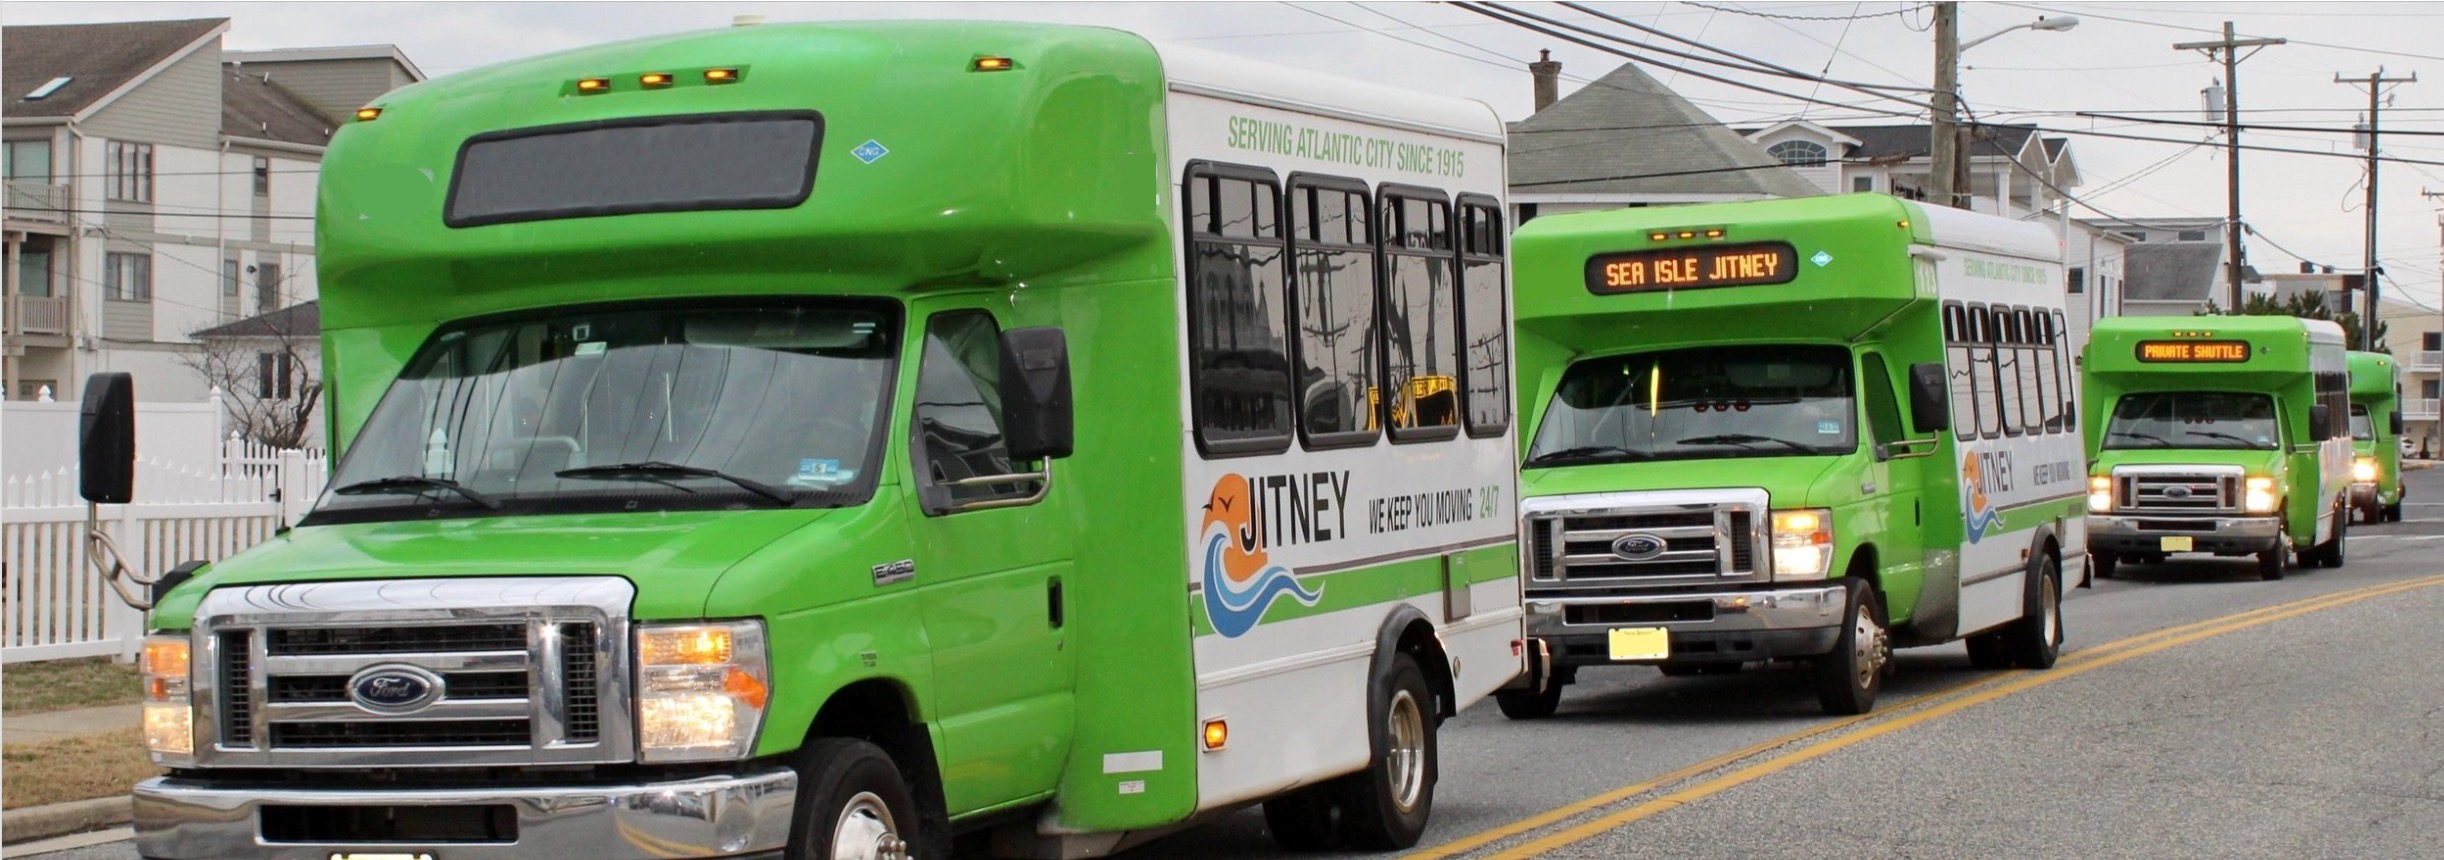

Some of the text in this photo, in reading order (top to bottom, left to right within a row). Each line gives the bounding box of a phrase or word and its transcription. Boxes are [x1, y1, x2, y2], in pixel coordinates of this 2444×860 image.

[858, 146, 879, 156] CNG
[1228, 115, 1464, 178] SERVING ATLANTIC CITY SINCE 1915
[1606, 253, 1778, 287] SEA ISLE JITNEY
[2144, 344, 2243, 358] PRIVATE SHUTTLE
[1976, 450, 2014, 495] JITNEY
[1240, 470, 1350, 553] JITNEY
[1369, 484, 1500, 534] WE KEEP YOU MOVING 24/7
[370, 677, 410, 698] Ford
